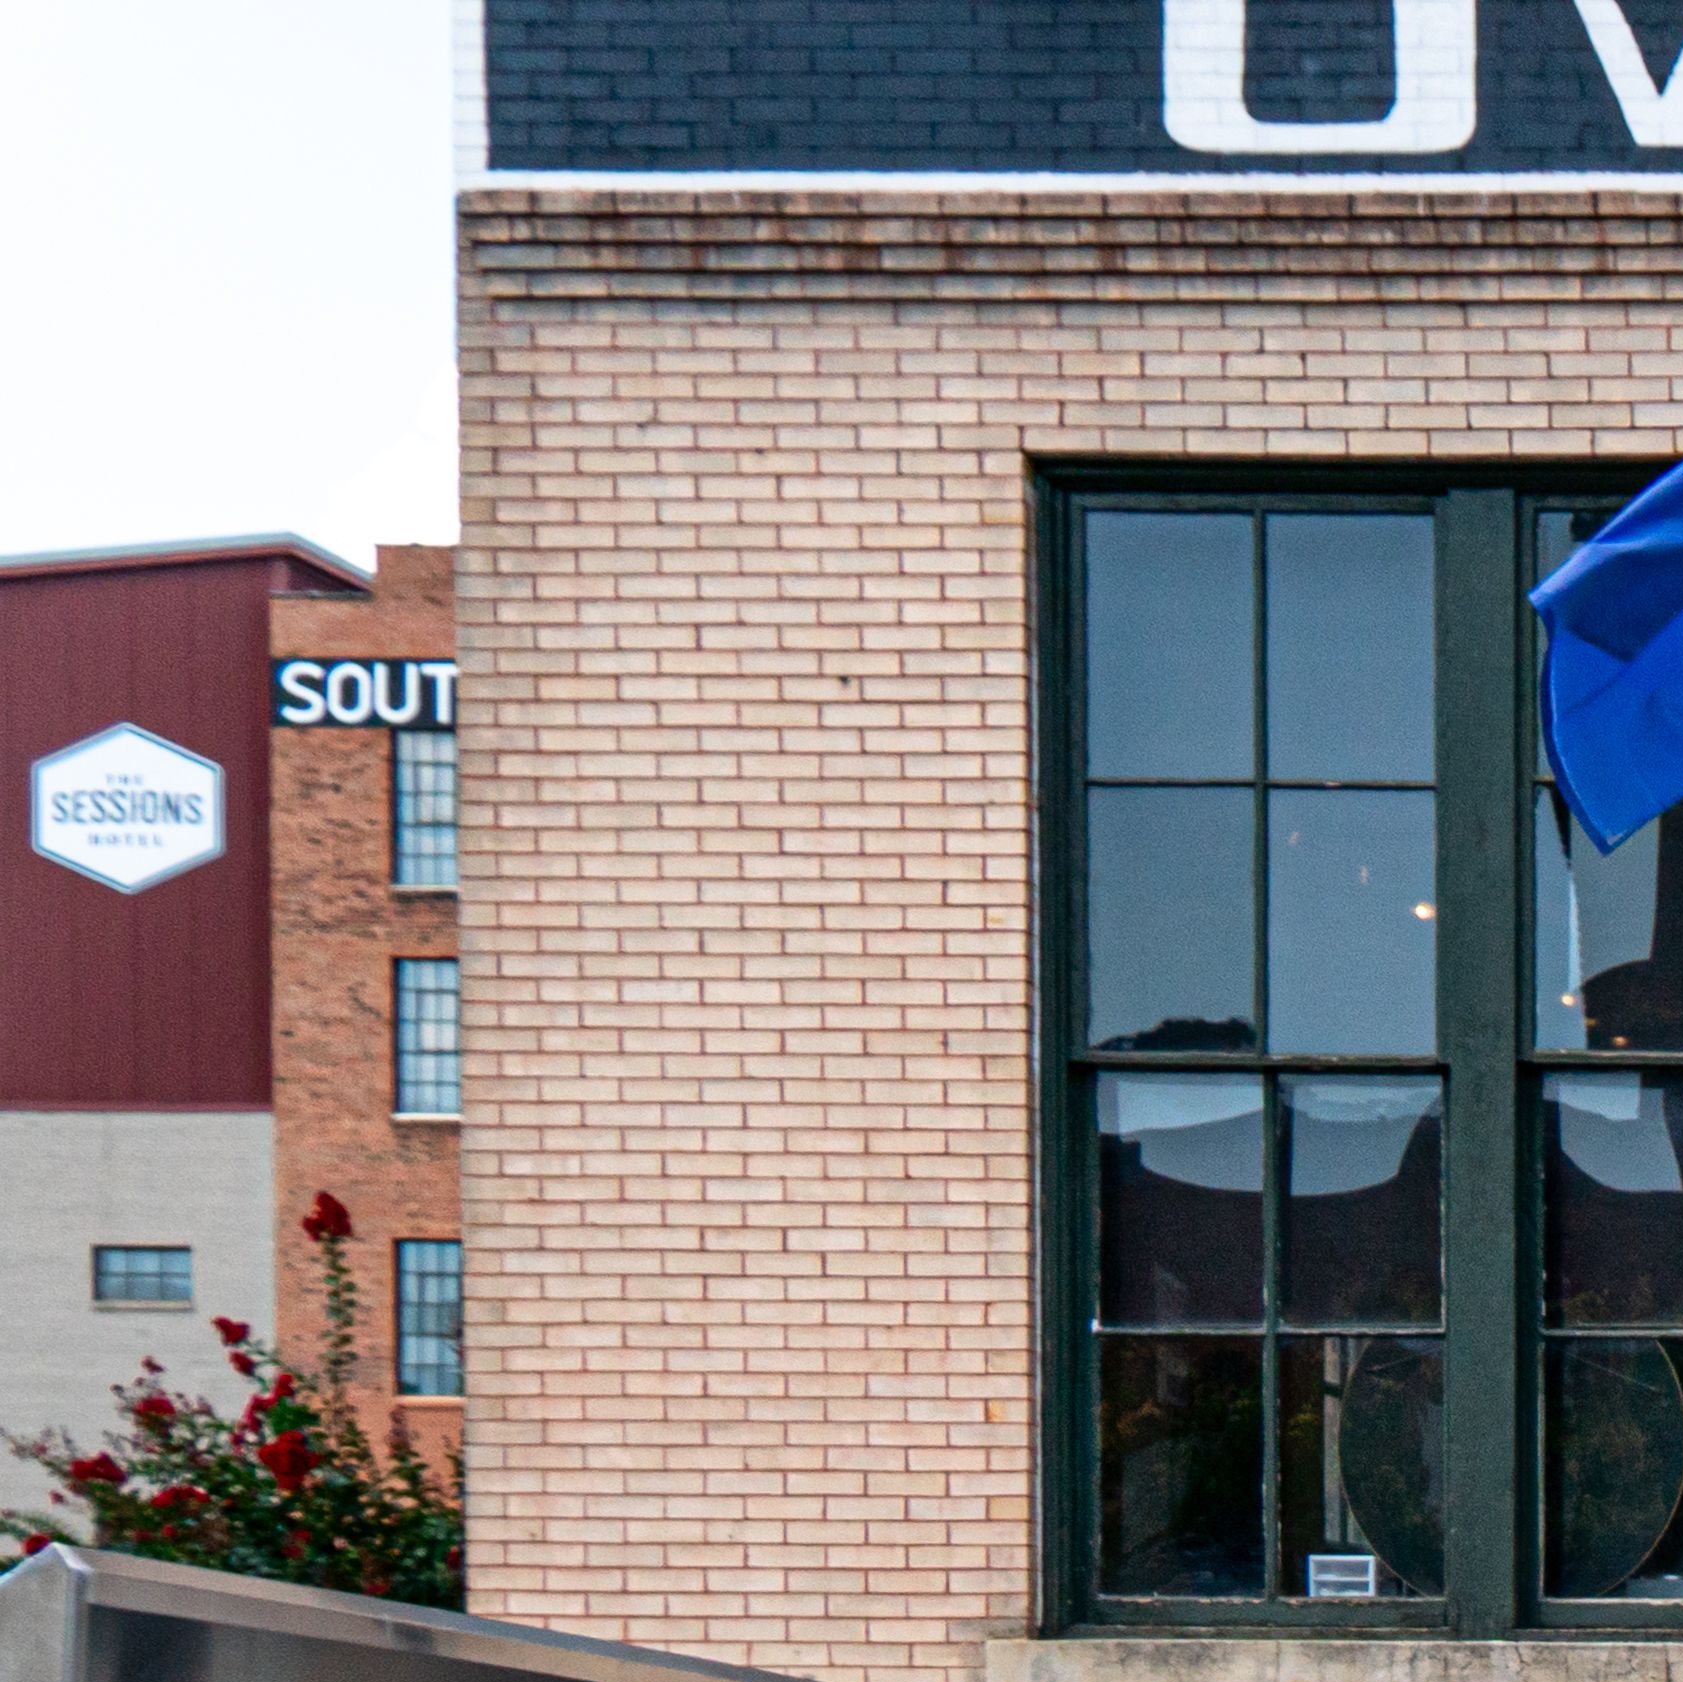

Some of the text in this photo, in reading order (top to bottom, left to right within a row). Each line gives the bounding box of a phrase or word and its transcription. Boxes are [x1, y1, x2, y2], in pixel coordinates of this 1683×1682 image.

[280, 660, 459, 725] SOUT
[105, 773, 144, 786] THE
[51, 789, 204, 825] SESSIONS
[88, 833, 163, 847] HOTEL
